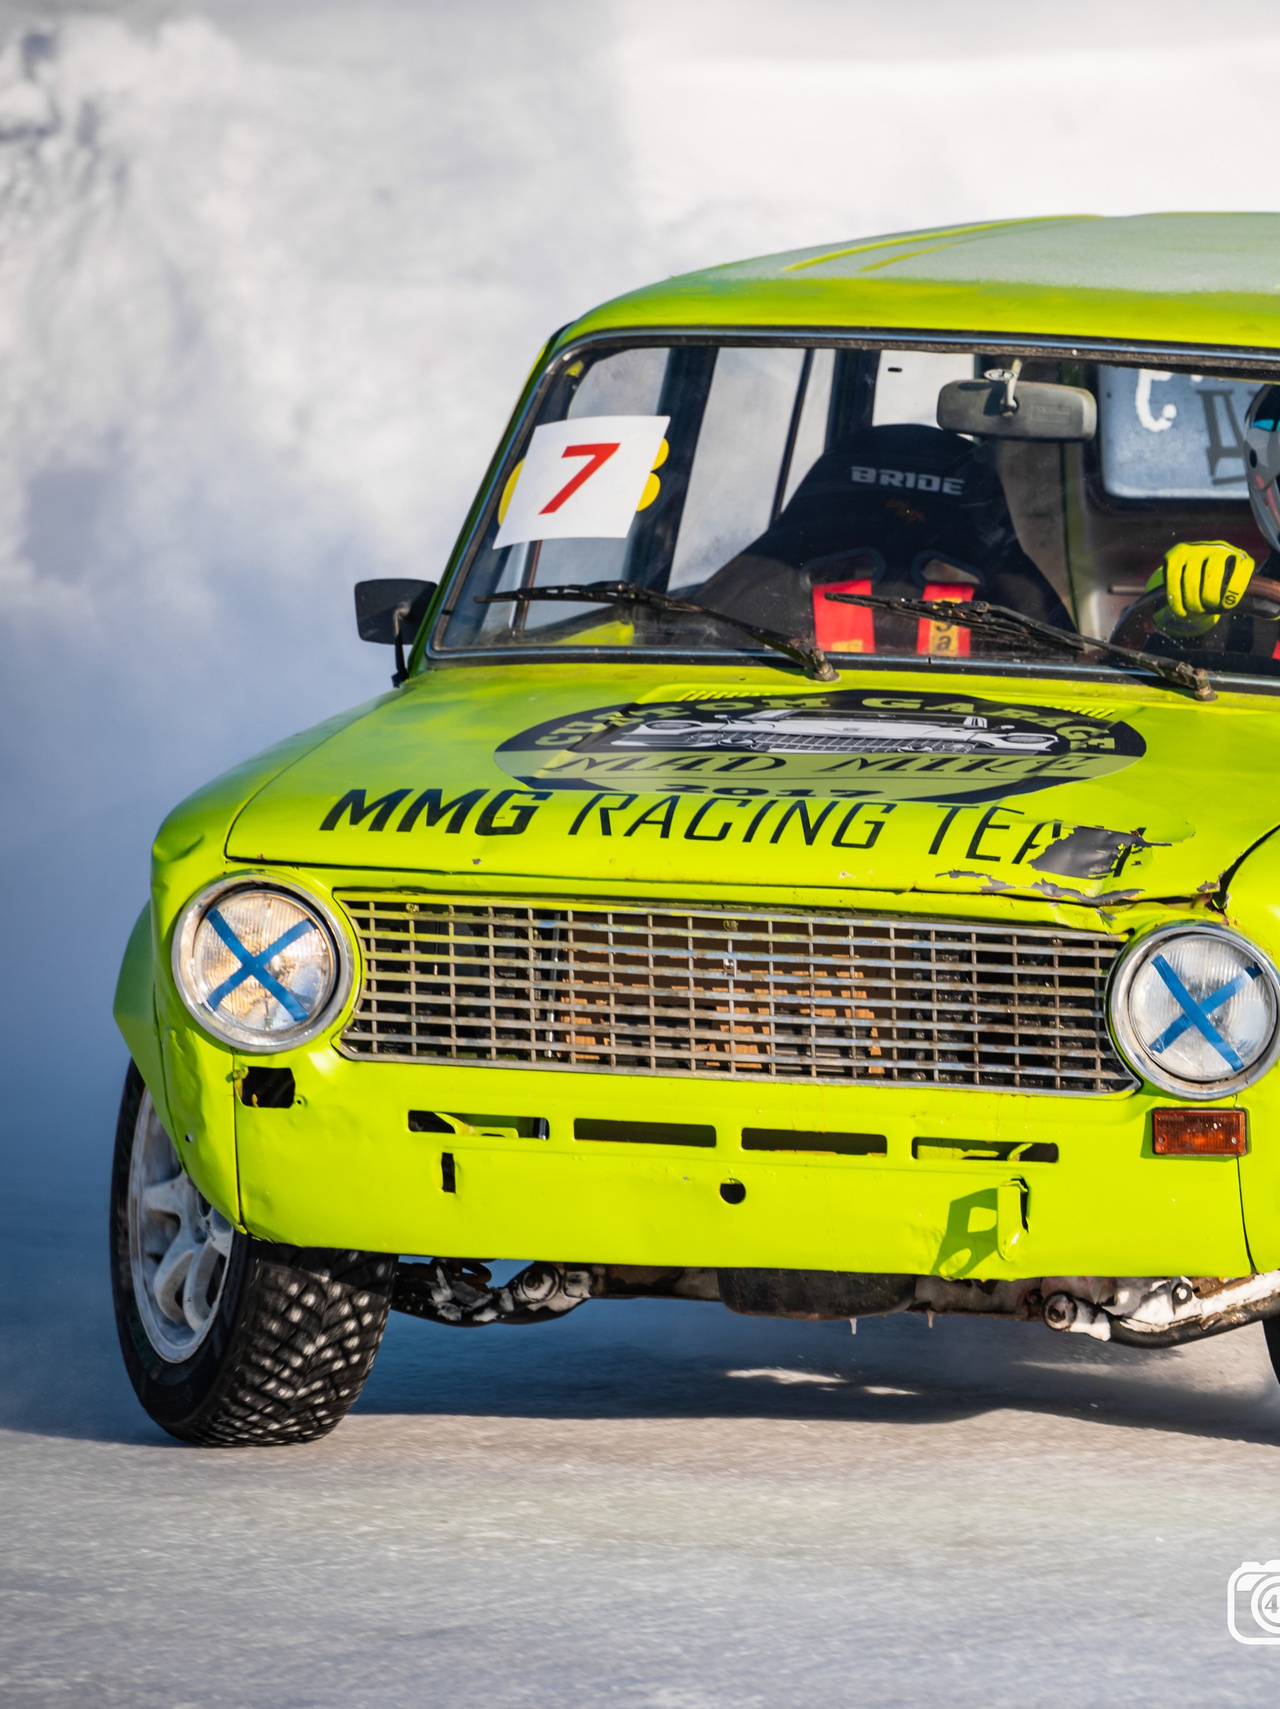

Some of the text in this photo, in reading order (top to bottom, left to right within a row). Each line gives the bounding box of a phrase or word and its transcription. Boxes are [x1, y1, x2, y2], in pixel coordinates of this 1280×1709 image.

[538, 442, 621, 515] 7
[851, 466, 965, 495] BRIDE
[535, 698, 1115, 750] CUSTOM GARAGE
[540, 755, 1101, 774] MAD MIKE
[655, 784, 885, 798] 2017
[319, 788, 554, 836] MMG
[568, 793, 898, 850] RACING
